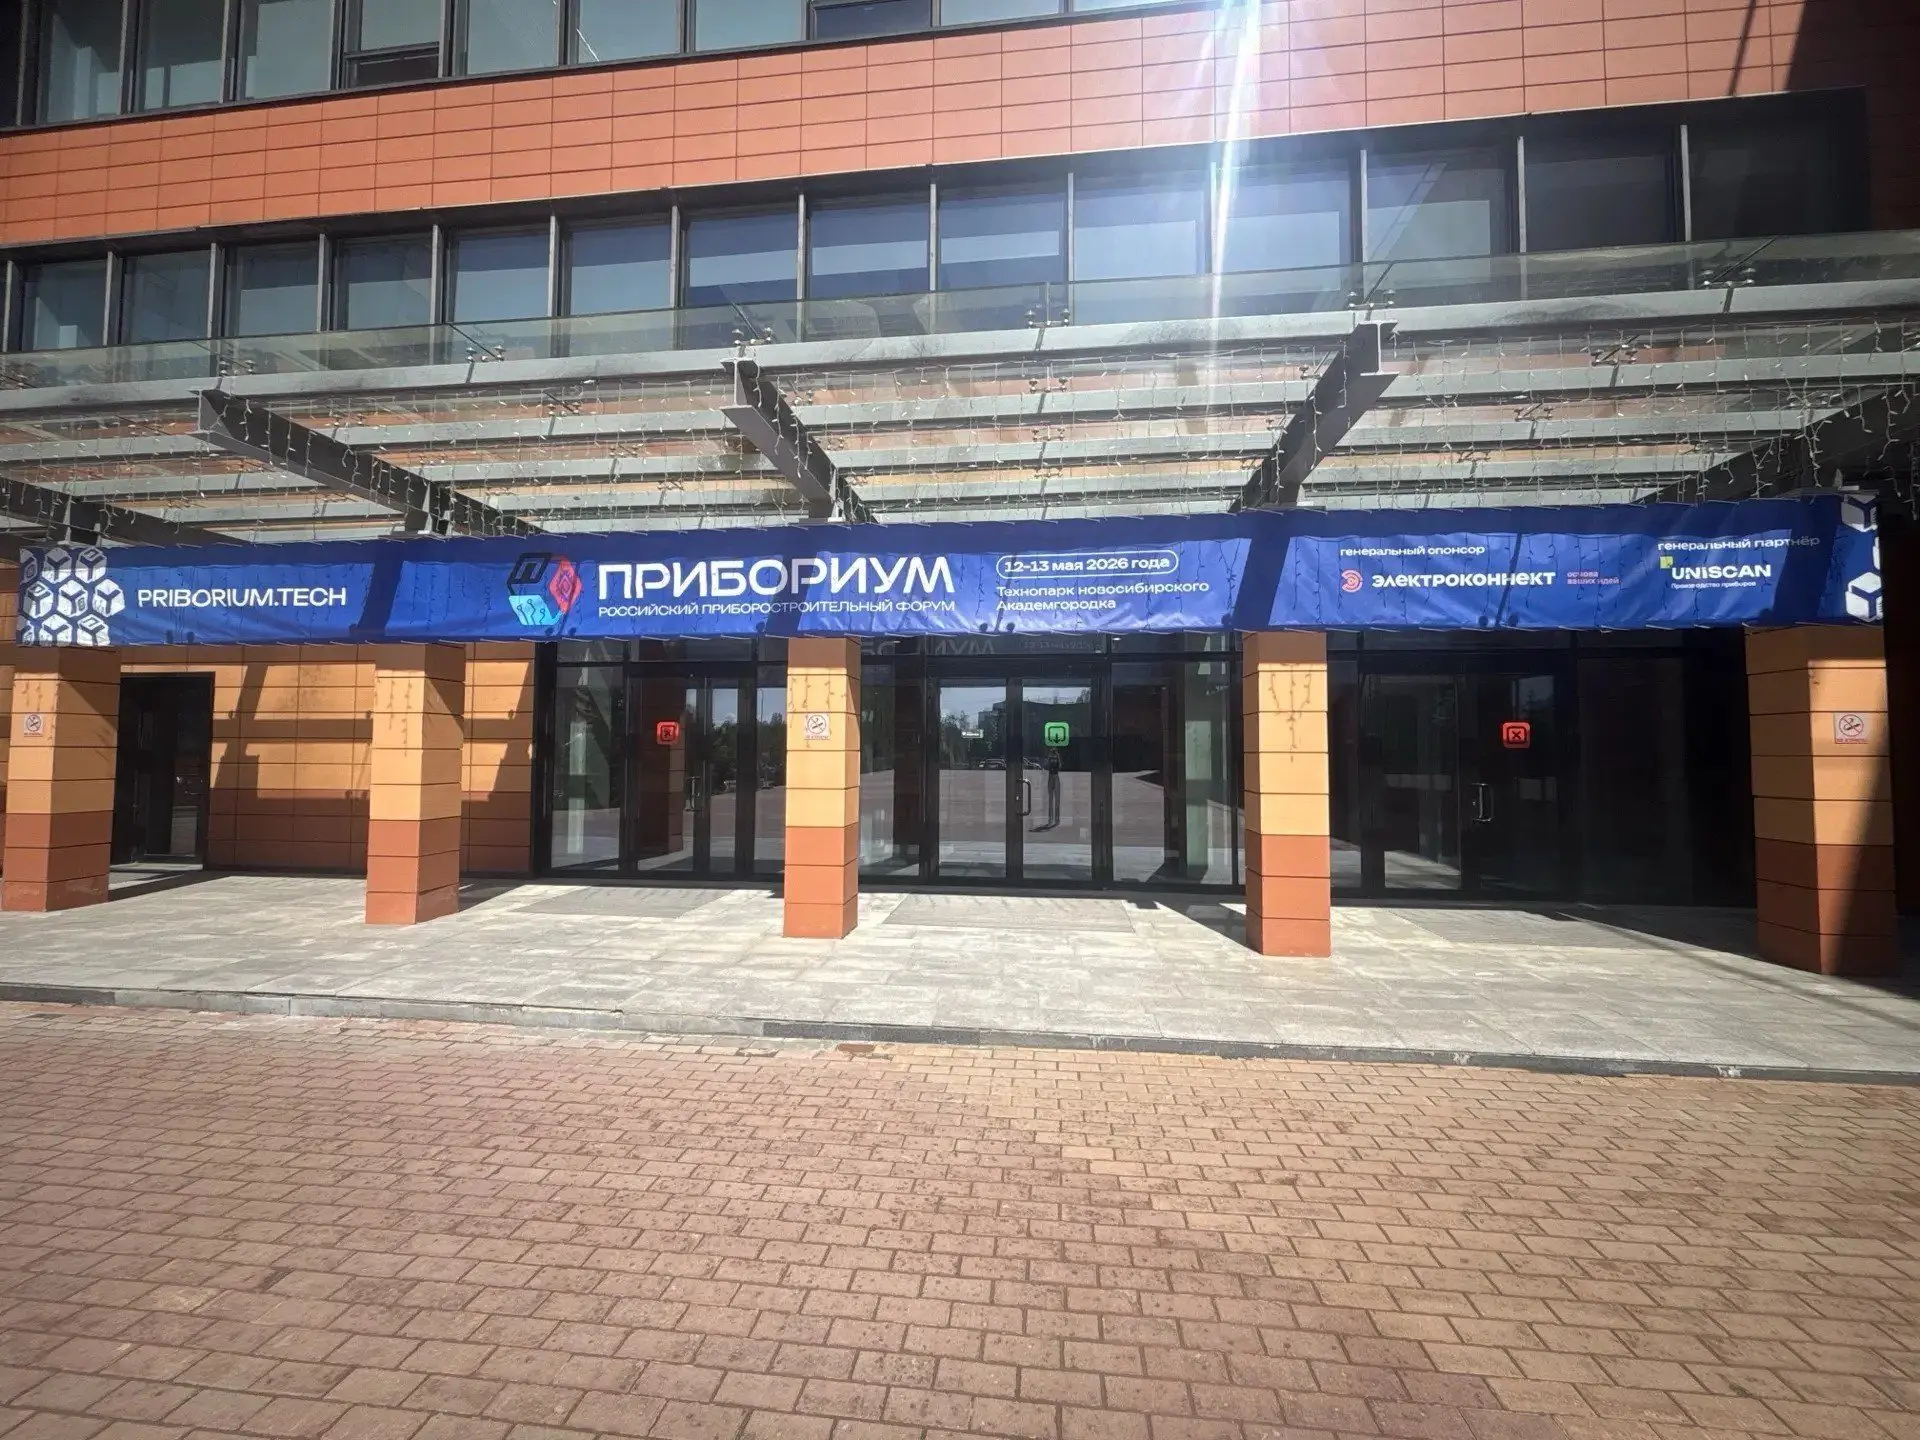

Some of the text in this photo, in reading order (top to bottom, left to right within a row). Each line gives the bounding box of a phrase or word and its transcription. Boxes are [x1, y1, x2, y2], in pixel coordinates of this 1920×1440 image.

[1340, 546, 1486, 556] генеральный спонсор
[1657, 536, 1821, 551] генеральный партнёр
[1004, 558, 1170, 573] 12-13 мая 2026 года
[1672, 565, 1771, 580] UNISCAN
[598, 556, 955, 598] ПРИБОРИУМ
[137, 586, 347, 608] PRIBORIUM.TECH
[996, 582, 1210, 598] Технопарк новосибирского
[599, 599, 955, 617] РОССИЙСКИЙ ПРИБОРОСТРОИТЕЛЬНЫЙ ФОРУМ
[996, 600, 1116, 612] Академгородка
